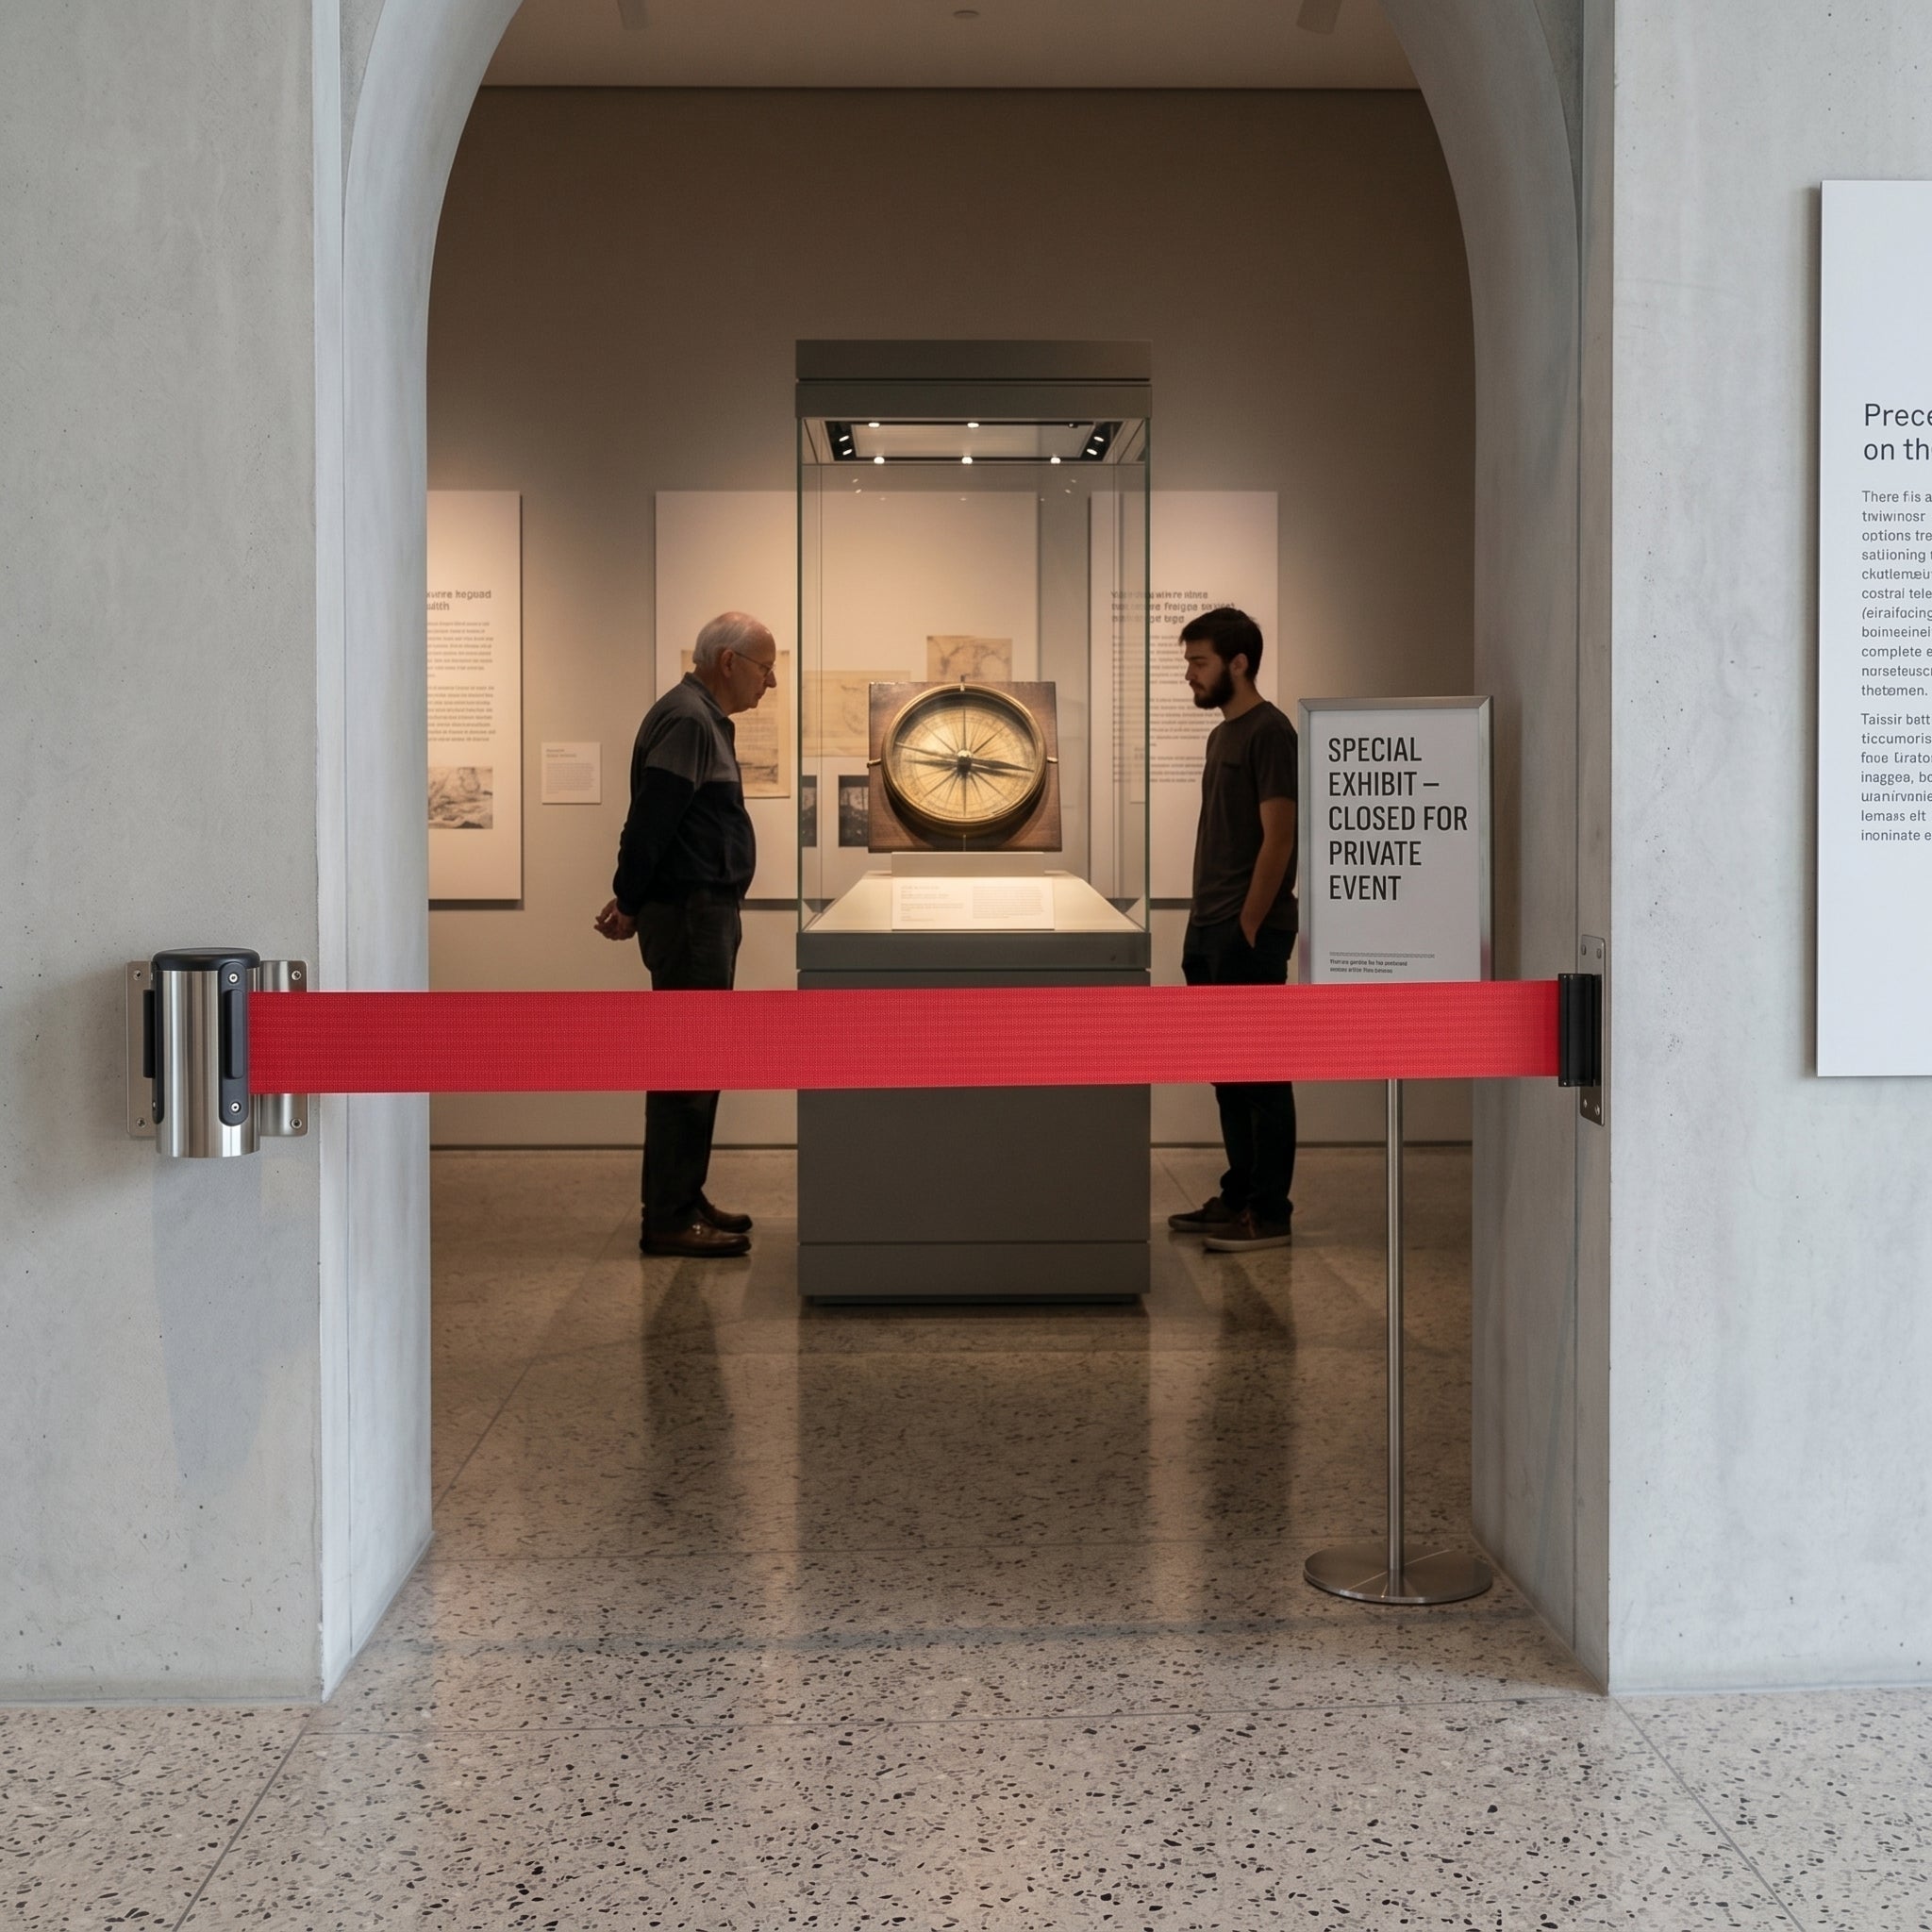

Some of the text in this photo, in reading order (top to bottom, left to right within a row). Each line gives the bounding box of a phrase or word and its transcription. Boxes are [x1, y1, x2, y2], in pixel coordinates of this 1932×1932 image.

[1864, 438, 1932, 460] on th
[1861, 491, 1899, 503] There
[1861, 529, 1911, 542] options
[1861, 646, 1923, 659] complete
[1860, 713, 1903, 724] Taissir
[1328, 737, 1422, 762] SPECIAL
[1329, 772, 1417, 796] EXHIBIT
[1328, 806, 1468, 831] CLOSED FOR
[1329, 841, 1422, 866] PRIVATE
[1330, 875, 1401, 900] EVENT
